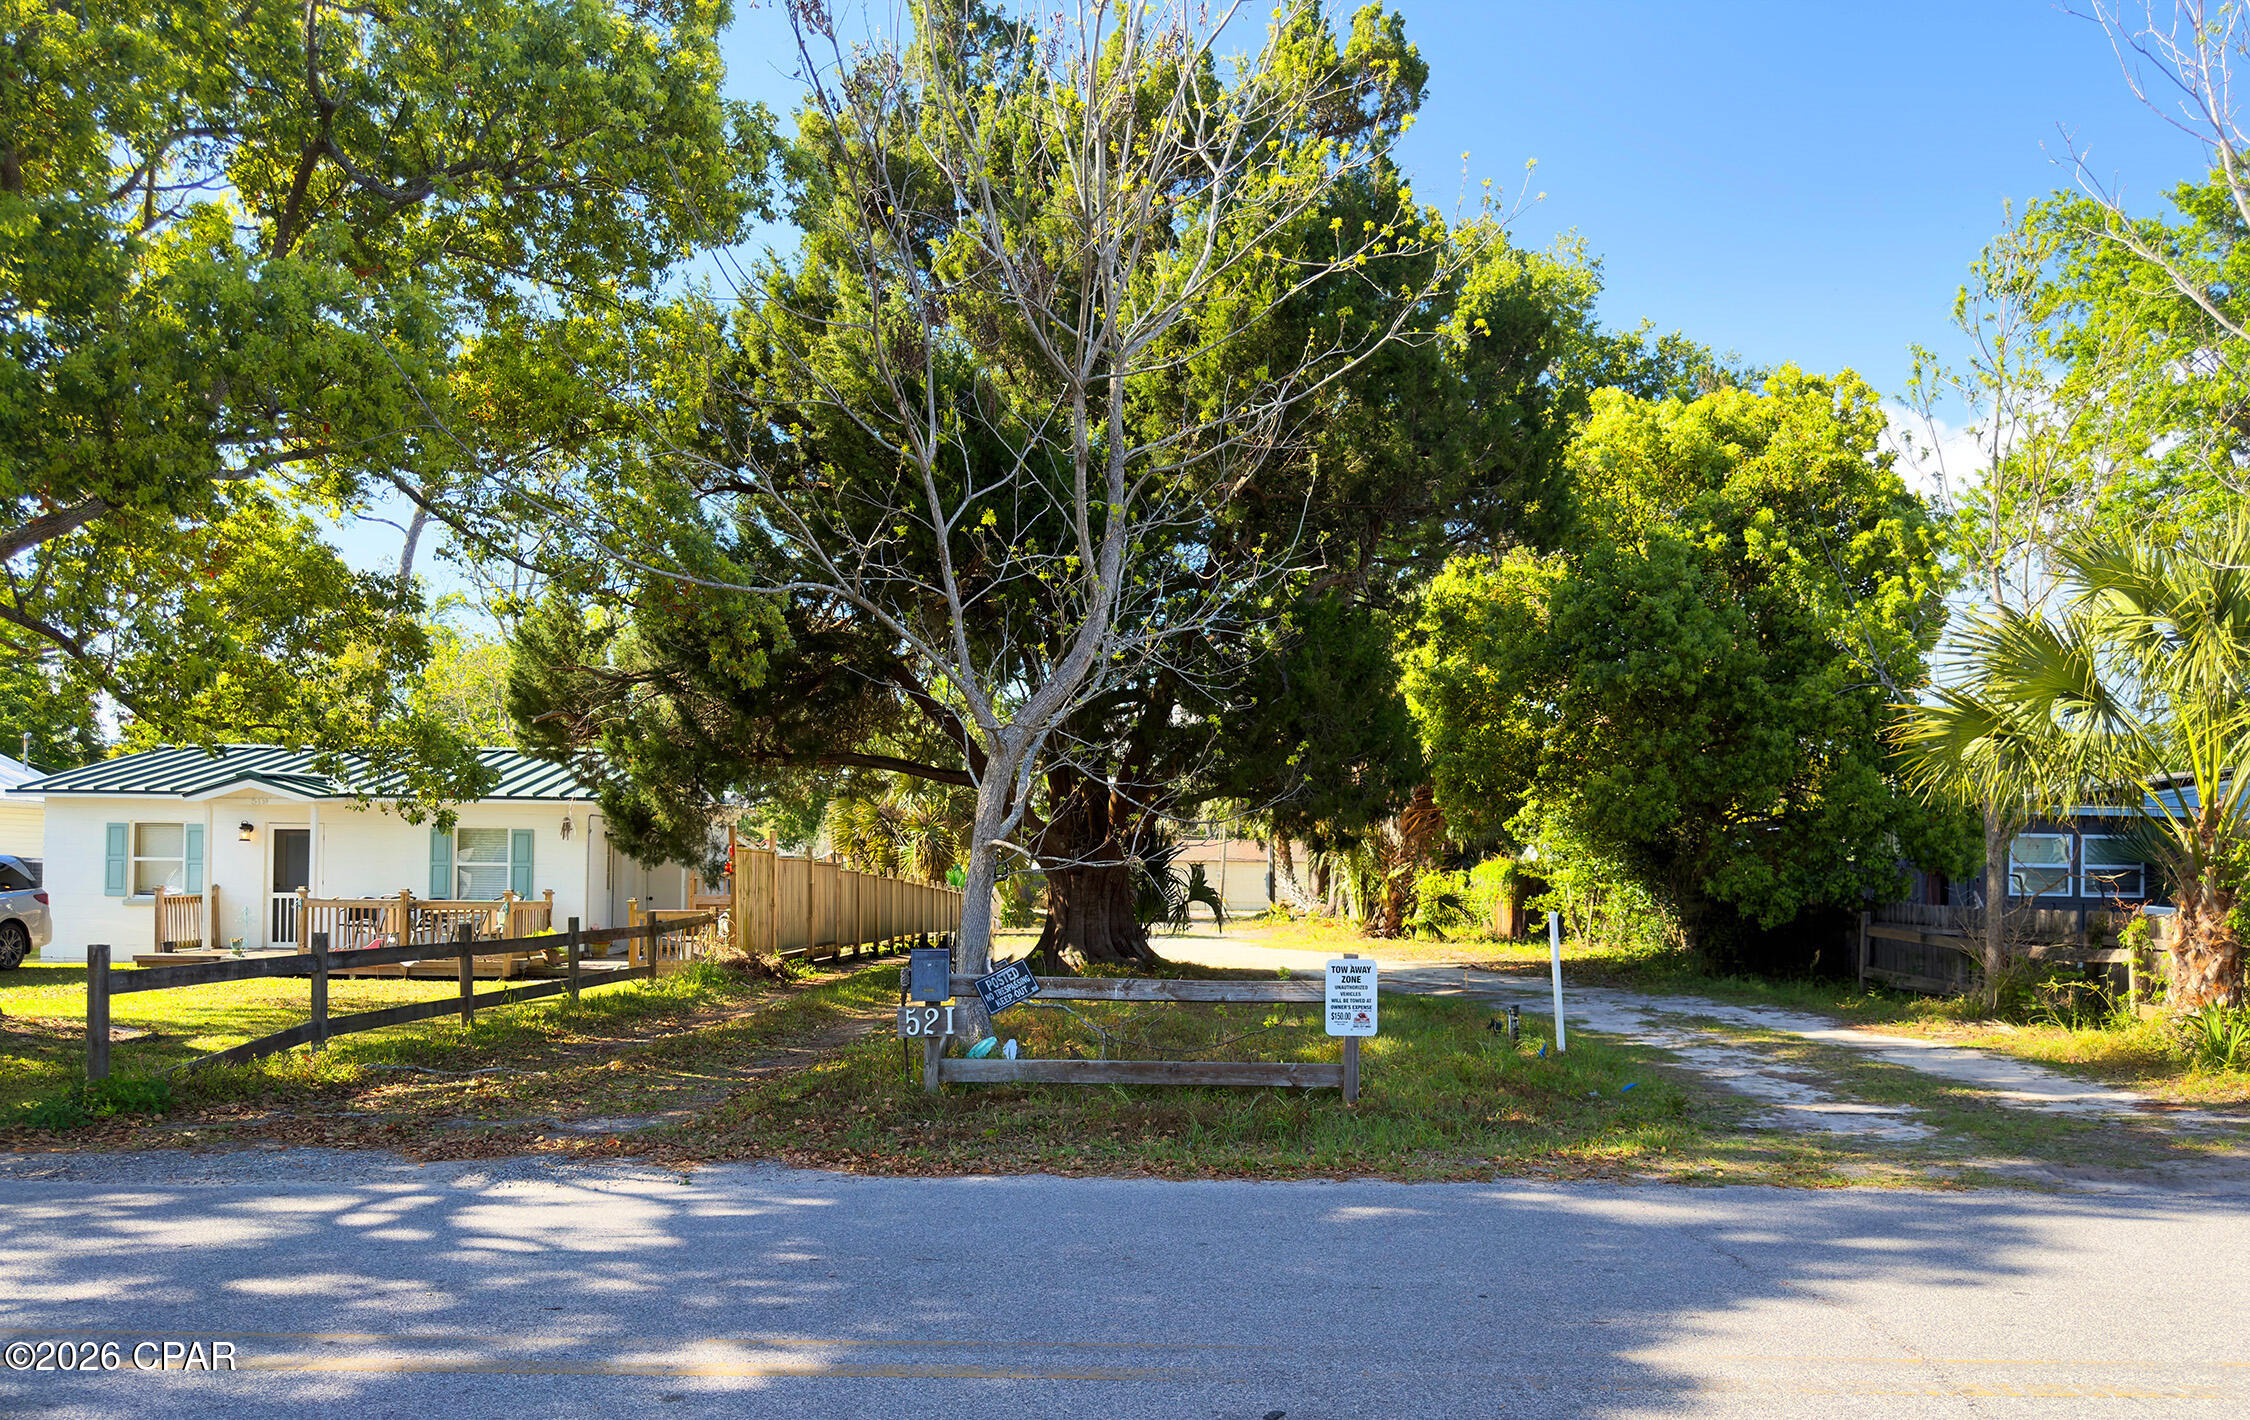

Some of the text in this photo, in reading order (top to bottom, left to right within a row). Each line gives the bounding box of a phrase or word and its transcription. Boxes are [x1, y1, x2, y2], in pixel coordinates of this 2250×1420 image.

[984, 967, 1020, 991] POSTED
[1331, 966, 1372, 974] TOW AWAY
[984, 992, 995, 1002] NO
[994, 974, 1031, 998] TRESPASSING
[995, 993, 1013, 1007] KEEP
[1014, 985, 1029, 998] OUT
[905, 1006, 955, 1036] 521
[1331, 1012, 1351, 1020] $150.00
